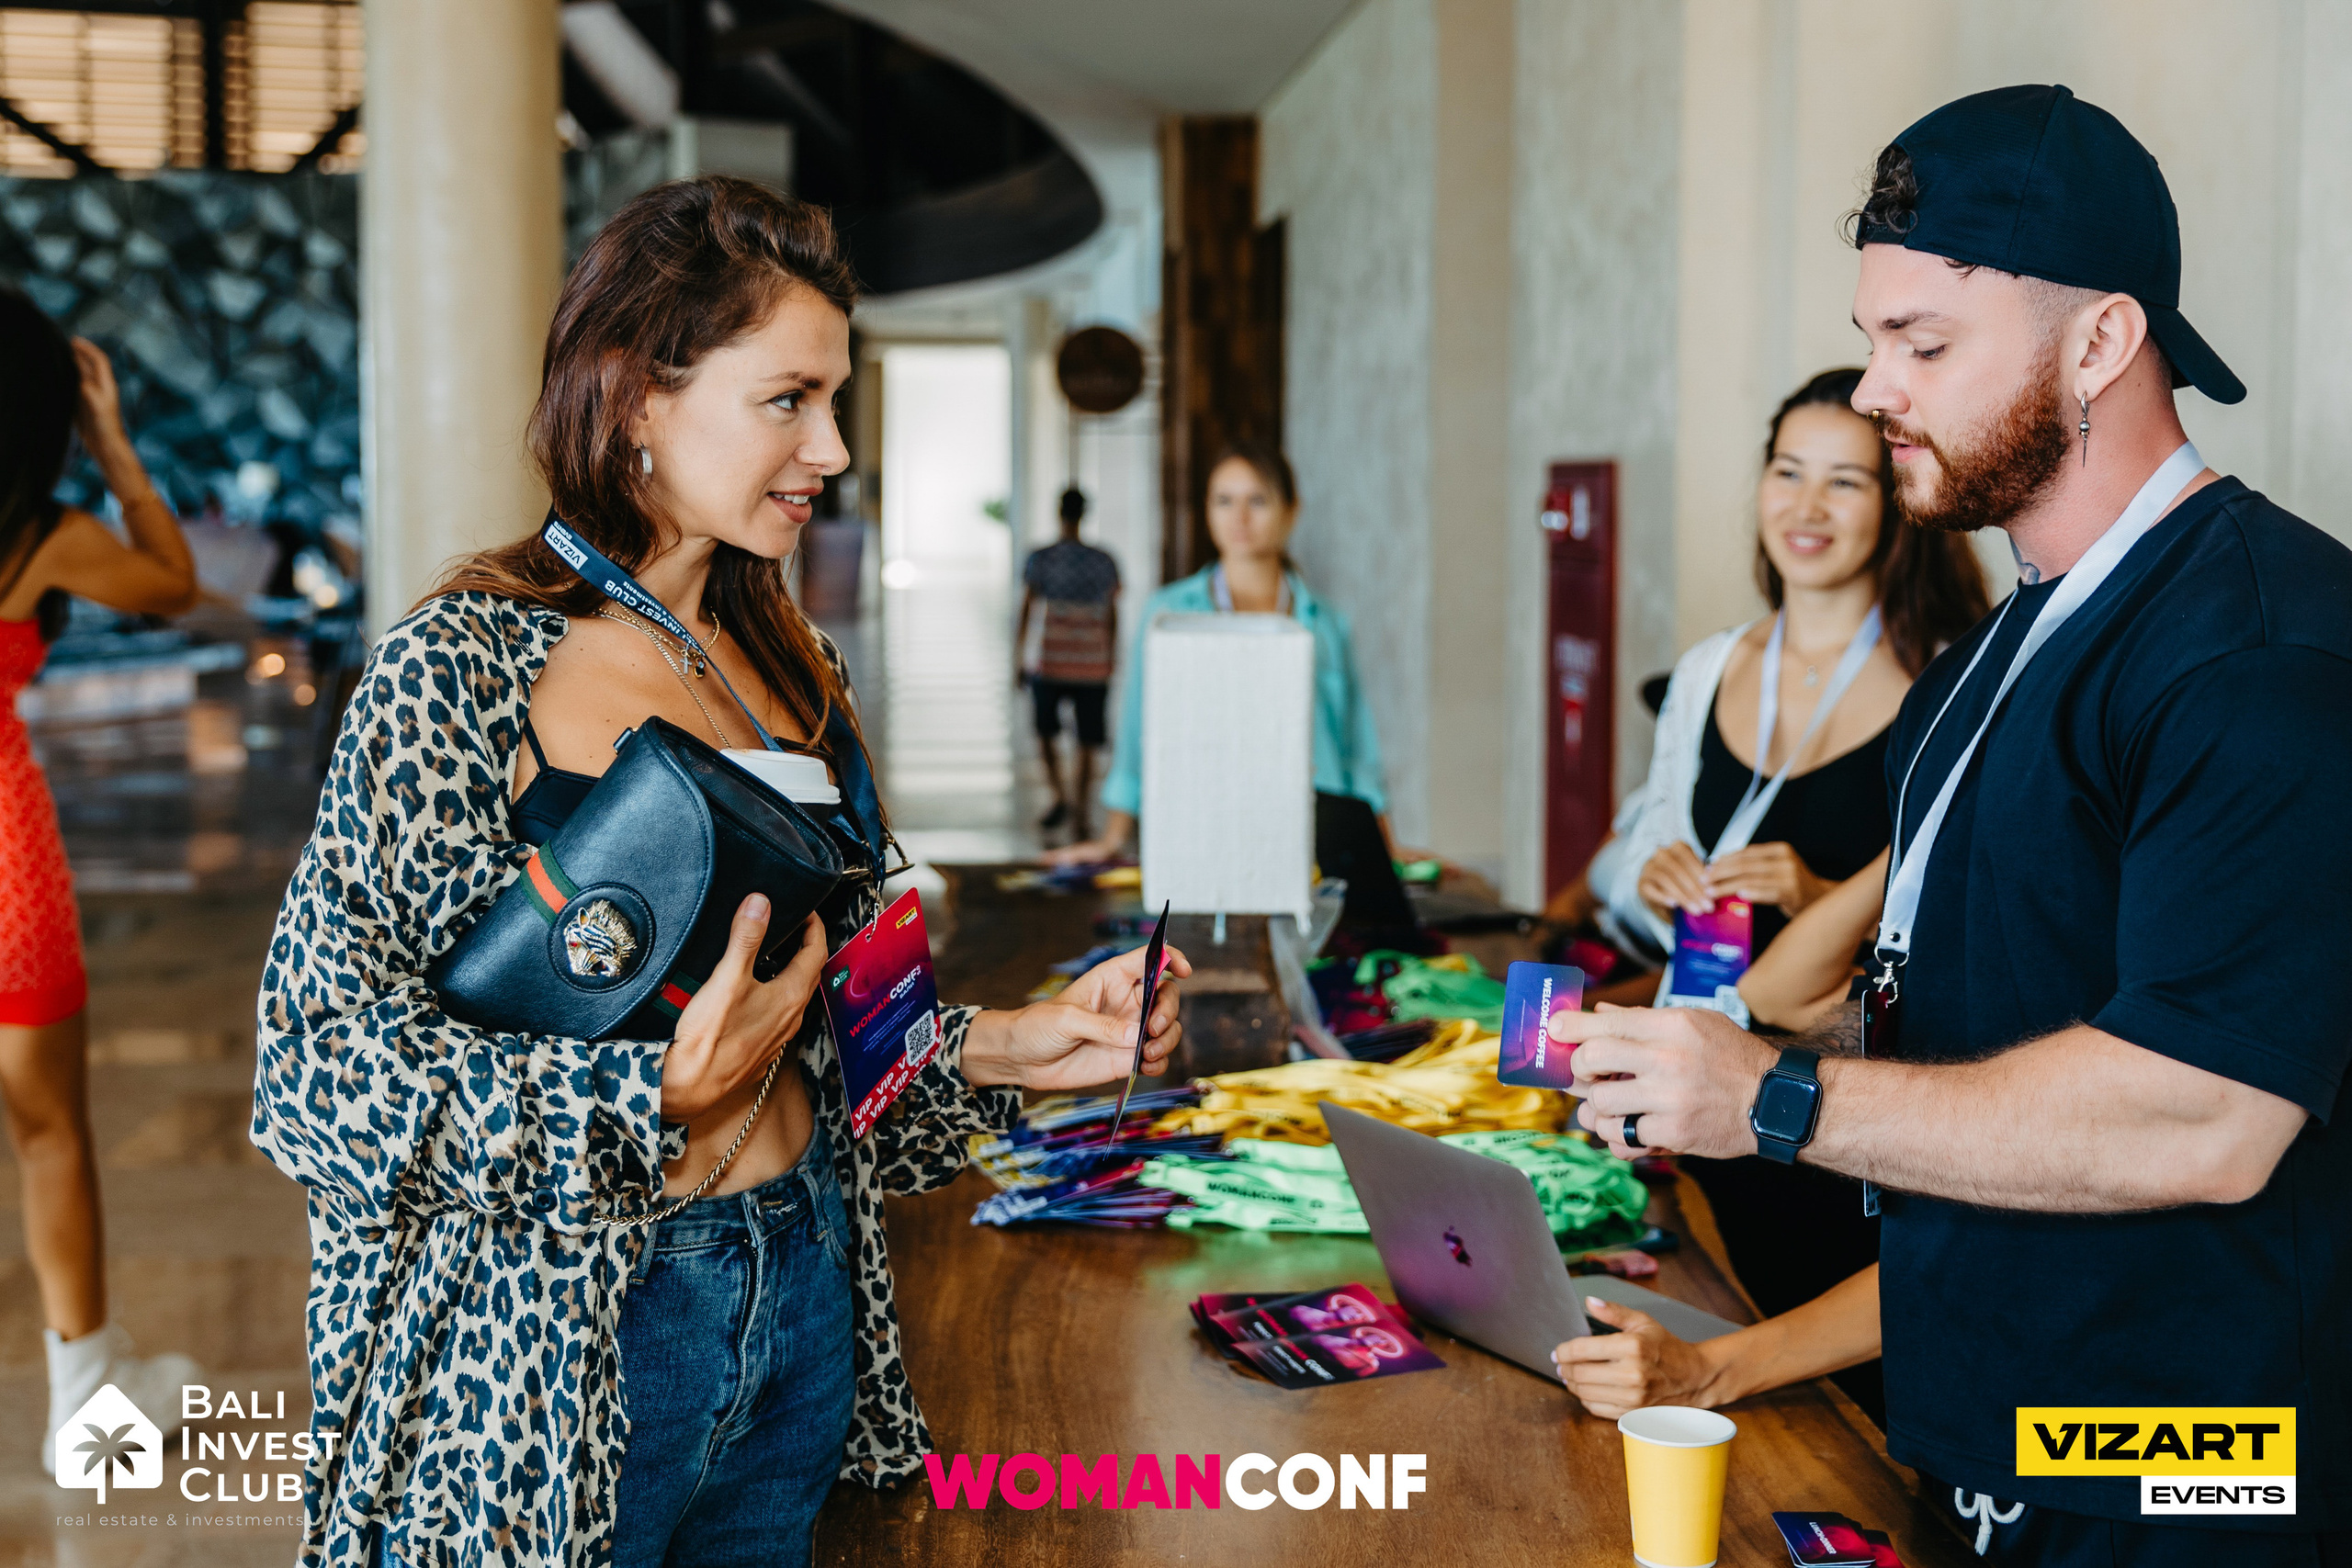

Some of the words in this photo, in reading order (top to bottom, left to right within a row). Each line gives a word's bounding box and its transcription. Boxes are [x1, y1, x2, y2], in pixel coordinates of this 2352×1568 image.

[548, 532, 581, 564] VIZART
[605, 579, 638, 606] CLUB
[622, 581, 662, 612] investments
[638, 604, 681, 635] INVEST
[1539, 976, 1553, 1028] WELCOME
[1535, 1028, 1547, 1069] COFFEE
[854, 1097, 873, 1122] VIP
[876, 1072, 895, 1095] VIP
[854, 1121, 866, 1139] IP
[869, 1095, 888, 1119] VIP
[891, 1069, 909, 1093] VIP
